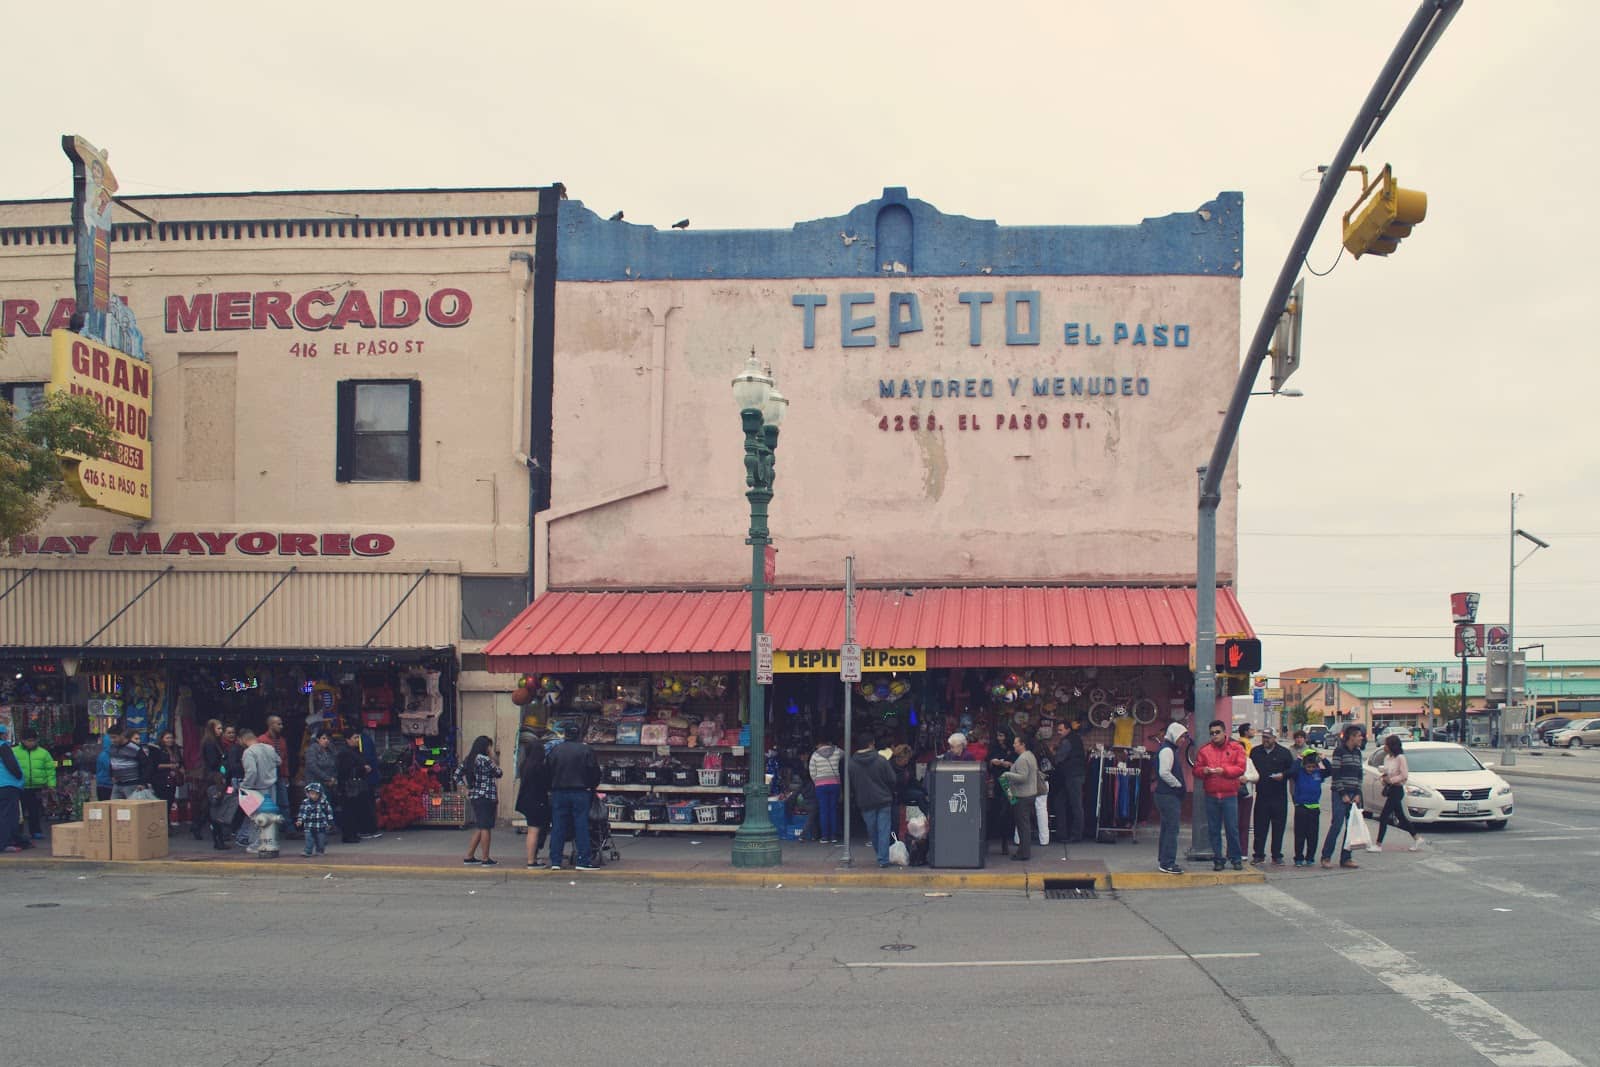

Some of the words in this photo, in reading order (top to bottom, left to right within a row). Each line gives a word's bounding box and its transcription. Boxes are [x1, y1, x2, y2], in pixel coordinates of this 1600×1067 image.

[164, 288, 473, 333] MERCADO
[1064, 323, 1102, 345] EL
[1113, 323, 1190, 347] PASO
[289, 342, 318, 358] 416
[333, 342, 350, 355] EL
[357, 340, 399, 356] PASO
[405, 340, 425, 354] ST
[71, 340, 149, 399] GRAN
[878, 378, 993, 398] MAYOREO
[1007, 377, 1020, 397] Y
[1032, 376, 1150, 397] MENUDEO
[878, 414, 920, 432] 426
[926, 414, 944, 431] S.
[958, 413, 981, 431] EL
[996, 413, 1048, 430] PASO
[1062, 412, 1091, 429] ST.
[108, 474, 117, 491] EL
[118, 477, 136, 496] PASO
[108, 531, 396, 556] MAYOREO
[786, 651, 841, 668] TEPIT
[863, 650, 876, 667] El
[879, 650, 917, 667] Paso
